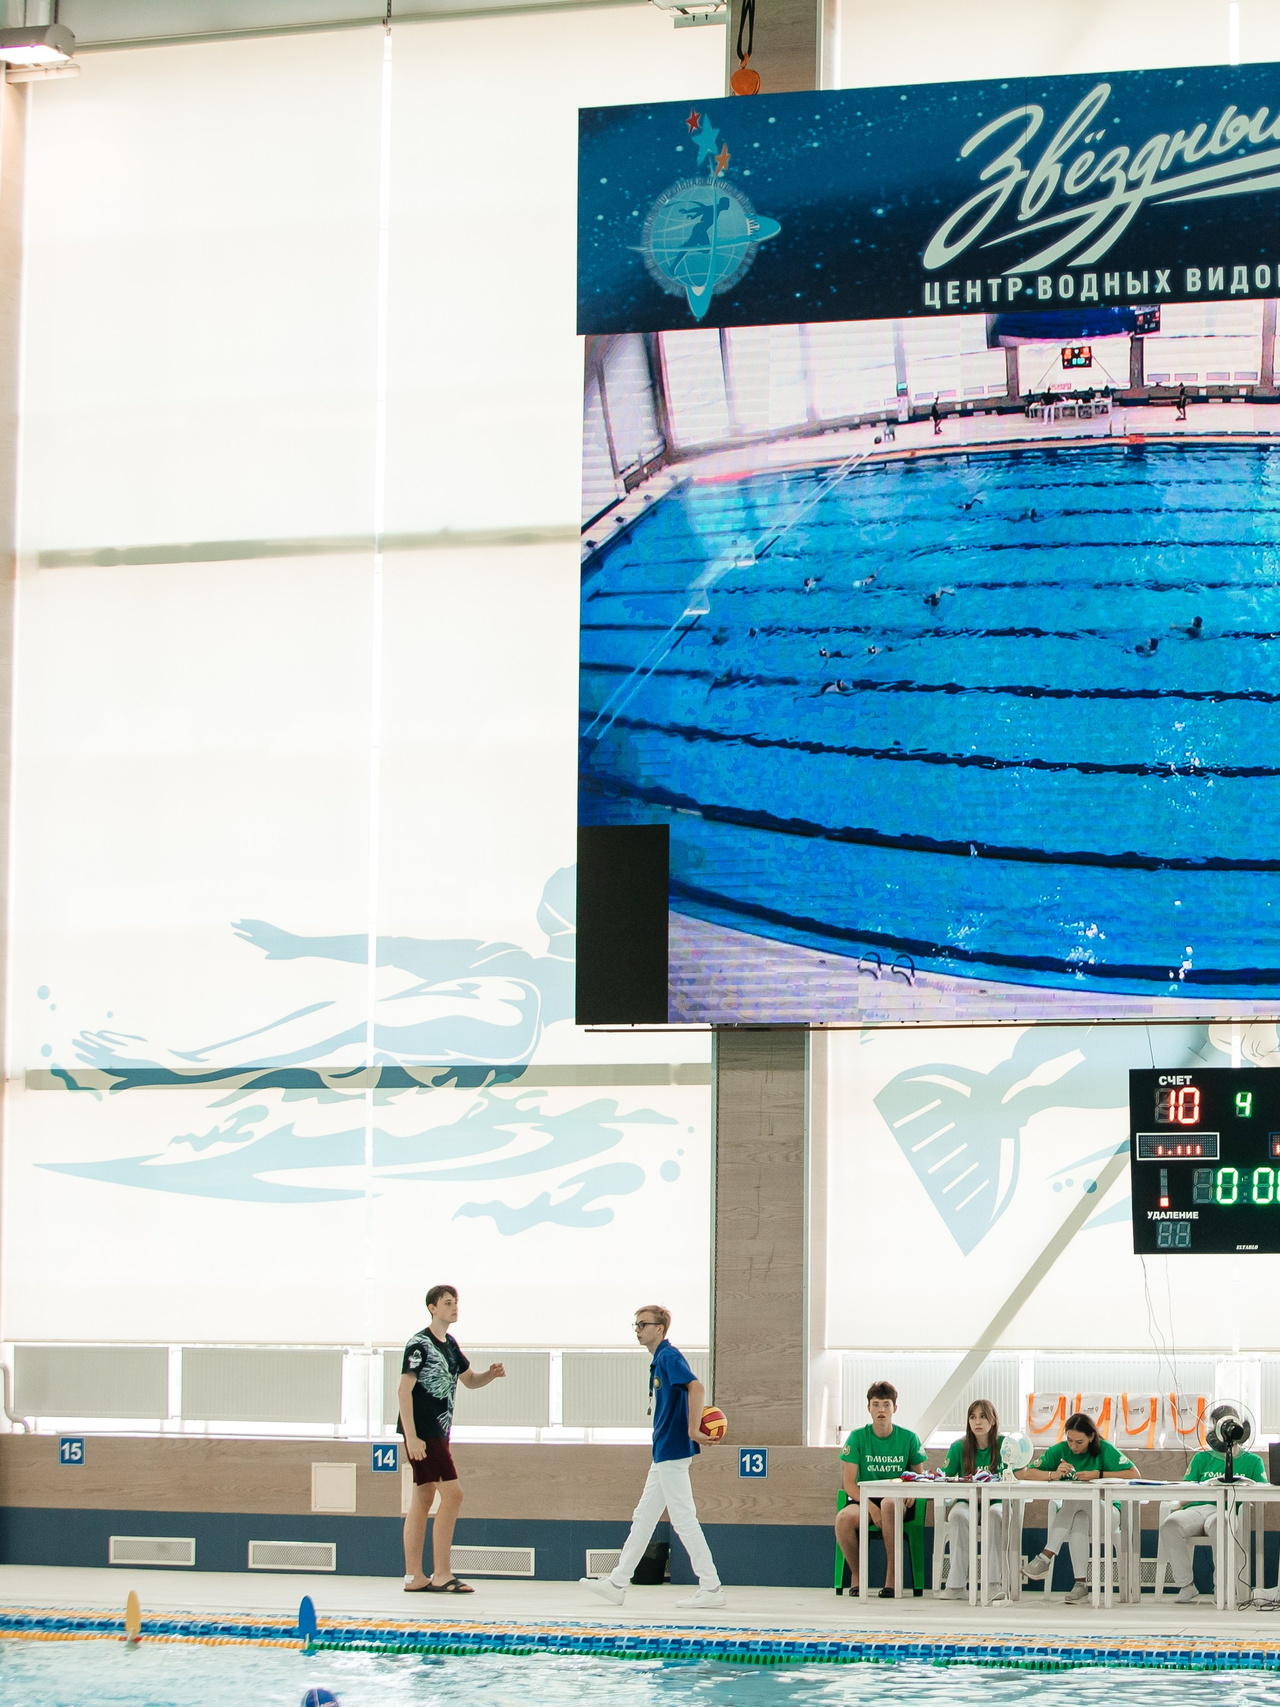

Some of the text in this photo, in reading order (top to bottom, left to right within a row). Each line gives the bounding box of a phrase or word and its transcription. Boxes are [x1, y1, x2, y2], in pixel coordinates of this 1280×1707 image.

[924, 276, 1024, 309] ЦЕНТР
[1038, 269, 1171, 302] ВОДНЫХ
[1158, 1075, 1193, 1086] СЧЕТ
[1168, 1087, 1200, 1124] 10
[1235, 1092, 1252, 1117] 4
[1147, 1211, 1199, 1220] УДАЛЕНИЕ
[61, 1442, 82, 1461] 15
[374, 1449, 395, 1467] 14
[741, 1454, 764, 1473] 13
